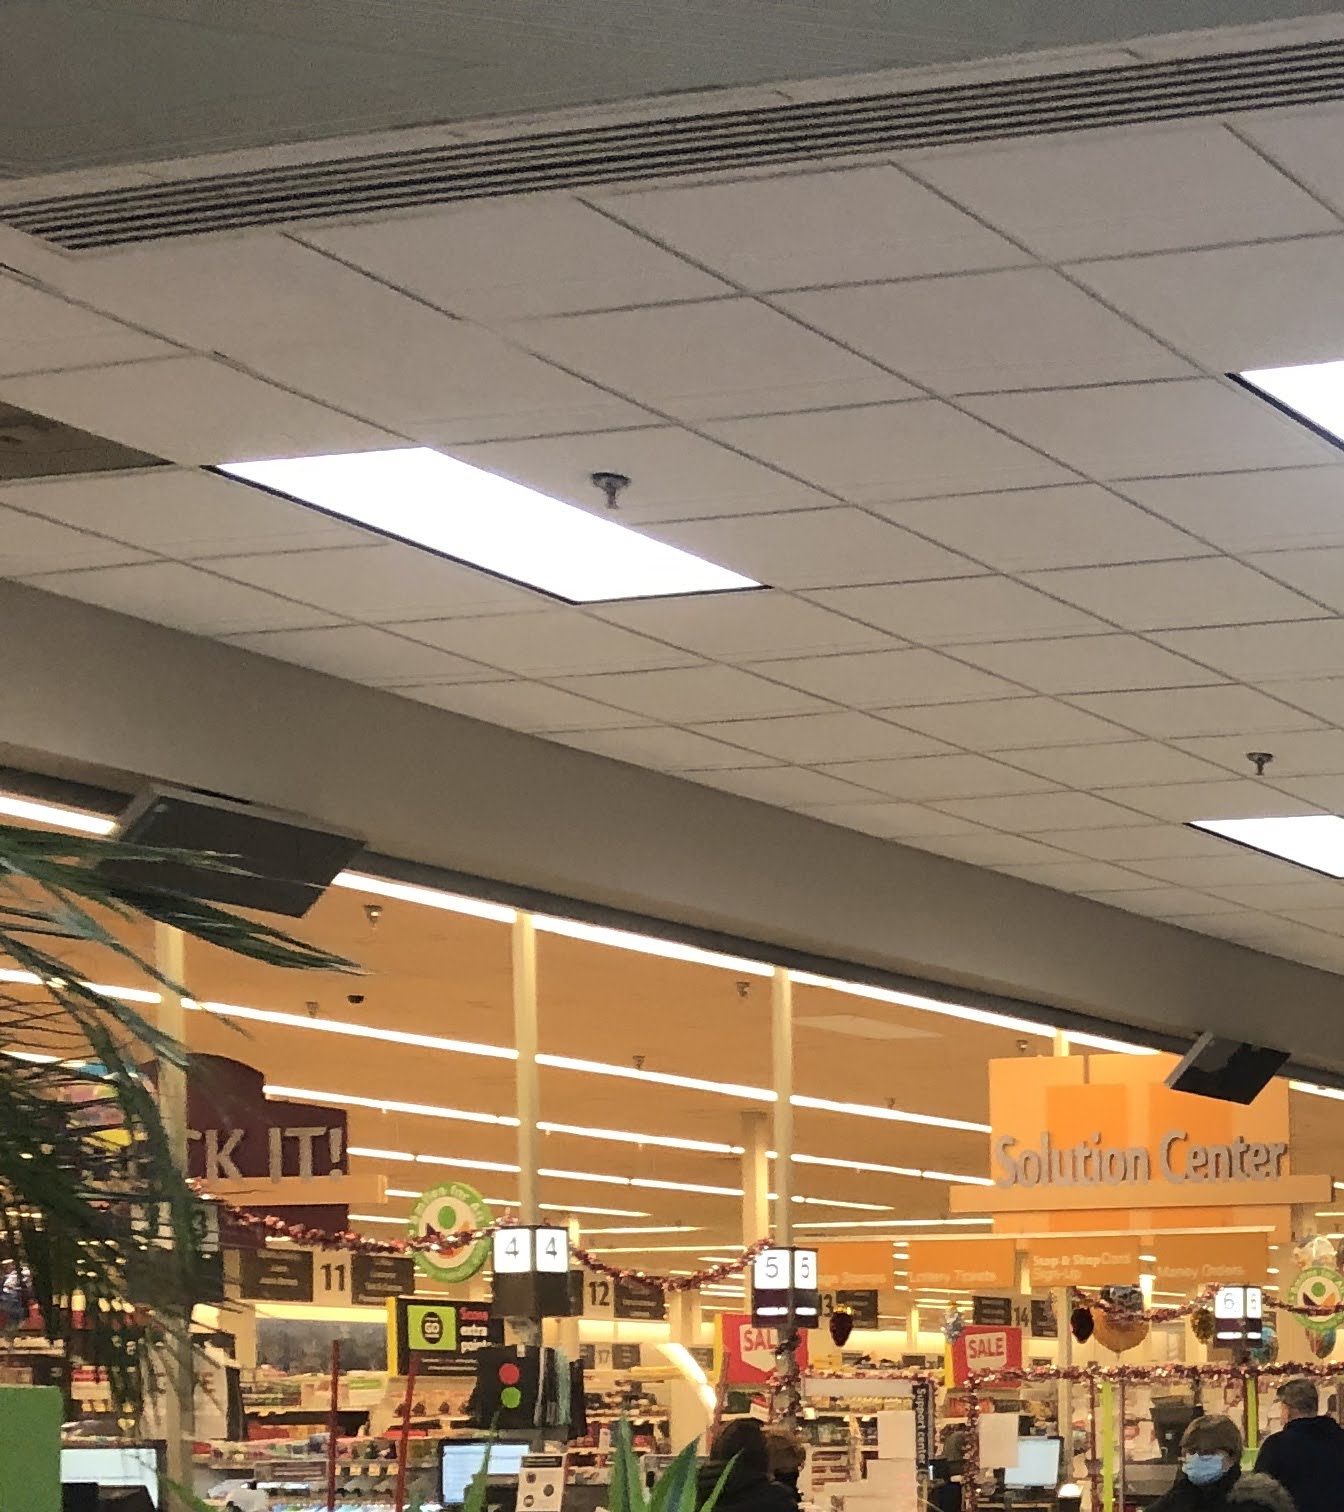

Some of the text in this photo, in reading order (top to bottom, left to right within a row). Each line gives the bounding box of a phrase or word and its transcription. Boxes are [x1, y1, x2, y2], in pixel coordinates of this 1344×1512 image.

[268, 1126, 343, 1183] IT!
[995, 1129, 1288, 1188] Solution Center
[505, 1237, 520, 1257] 4
[545, 1237, 558, 1257] 4
[320, 1263, 345, 1291] 11
[765, 1257, 779, 1278] 5
[801, 1257, 810, 1278] 5
[588, 1280, 610, 1307] 12
[1224, 1292, 1235, 1310] 6
[1012, 1306, 1029, 1326] 14
[744, 1329, 777, 1351] SAL
[967, 1336, 1005, 1359] SALE
[916, 1387, 927, 1430] Support
